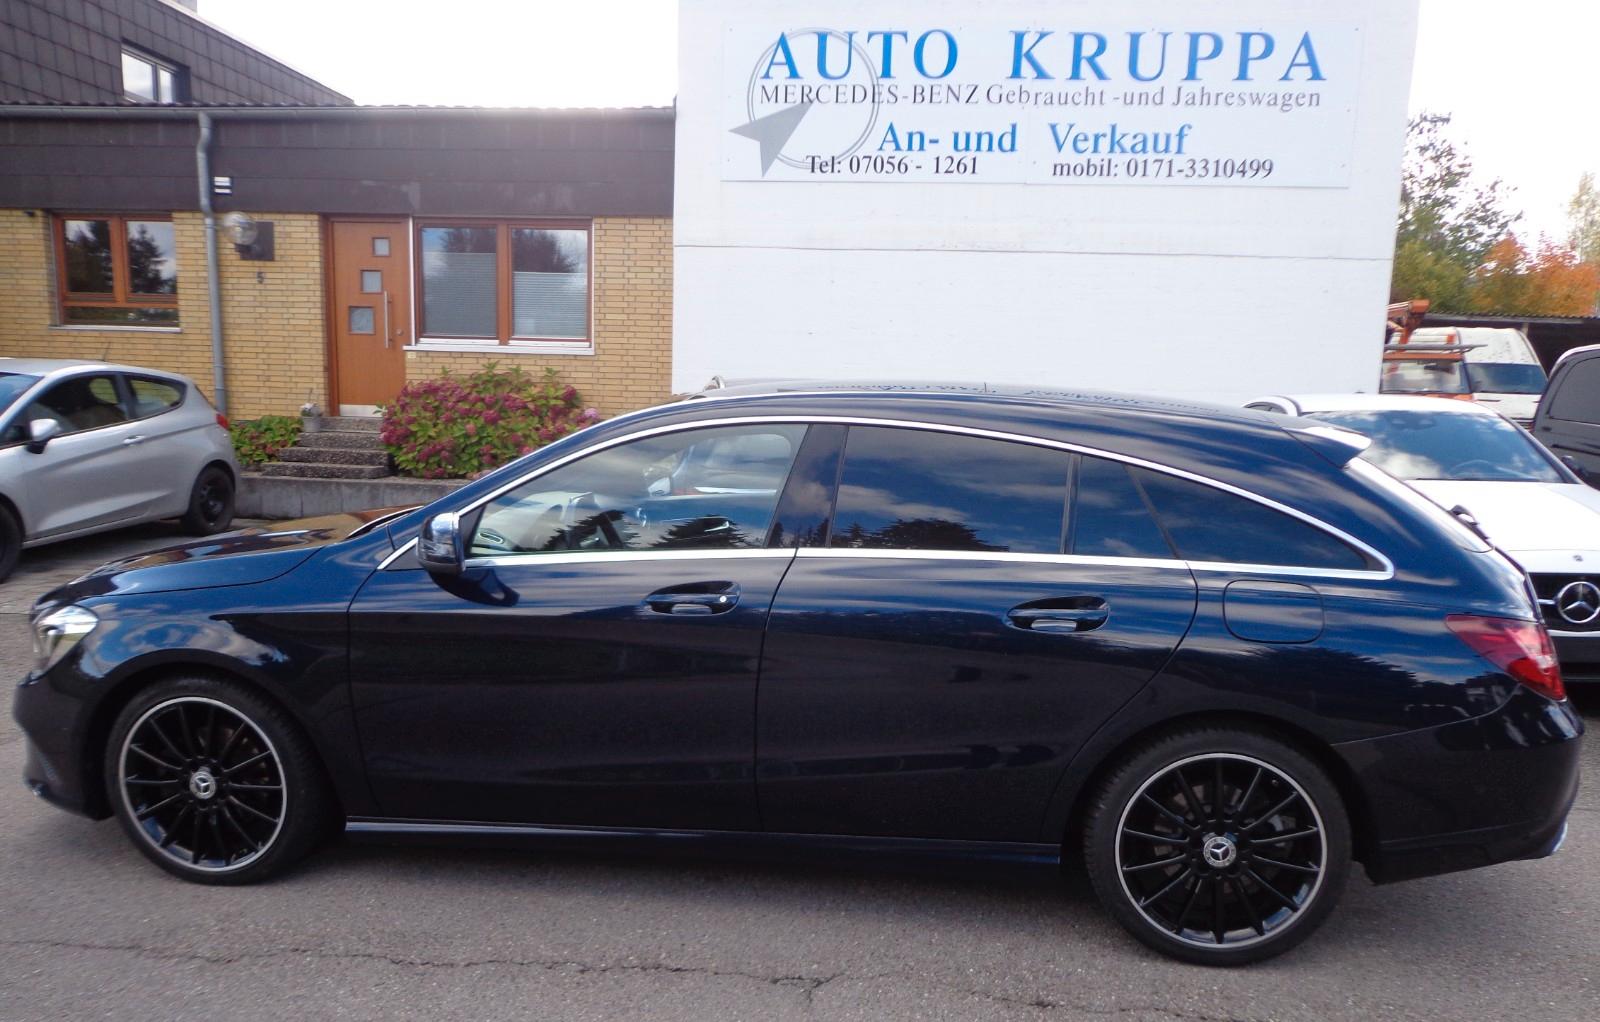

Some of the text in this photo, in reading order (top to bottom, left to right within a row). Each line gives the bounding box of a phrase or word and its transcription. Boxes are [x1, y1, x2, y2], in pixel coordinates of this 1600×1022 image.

[760, 28, 1327, 82] AUTO KRUPPA
[760, 84, 979, 104] MERCEDES-BENZ
[986, 84, 1105, 106] Gebraucht
[1172, 86, 1321, 112] Jahreswagen
[878, 121, 1192, 154] An- und Verkauf
[805, 155, 842, 174] Tel:
[849, 155, 909, 174] 07056
[934, 155, 979, 175] 1261
[1052, 158, 1274, 178] mobil: 0171-3310499
